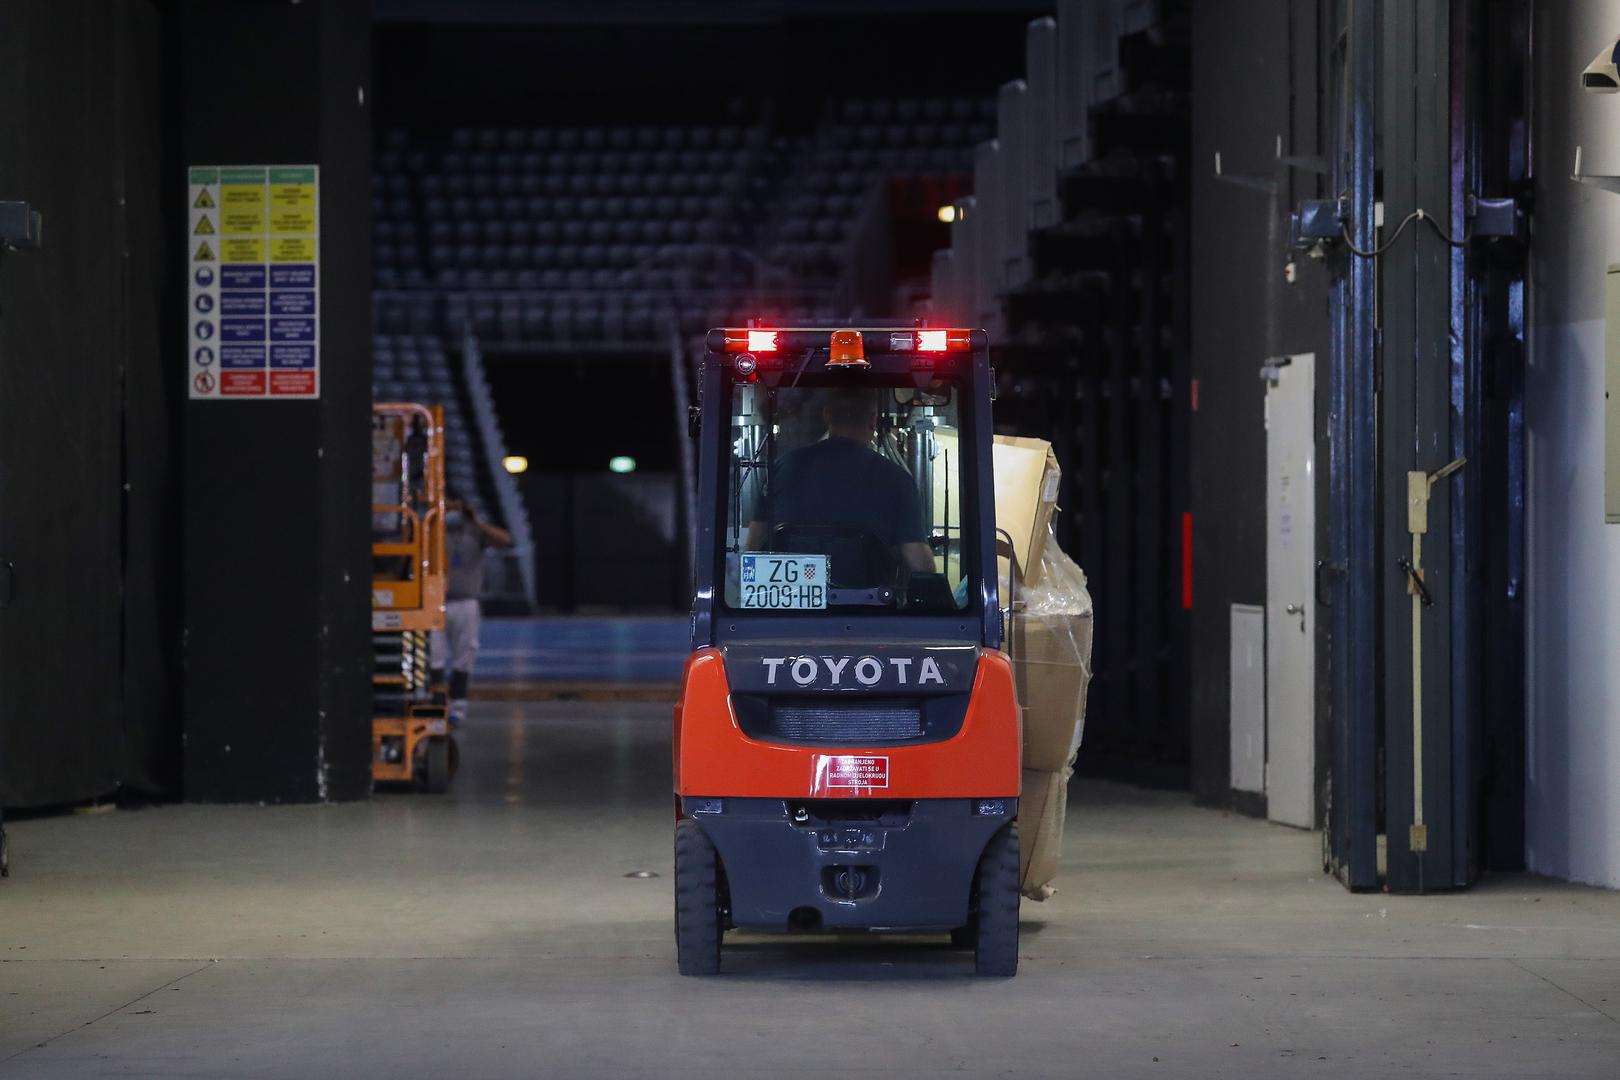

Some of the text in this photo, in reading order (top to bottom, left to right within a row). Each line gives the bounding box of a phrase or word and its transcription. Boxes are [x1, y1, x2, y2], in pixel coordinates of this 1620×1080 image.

[769, 560, 798, 583] ZG
[765, 585, 822, 608] 2009-HB
[762, 656, 945, 686] TOYOTA
